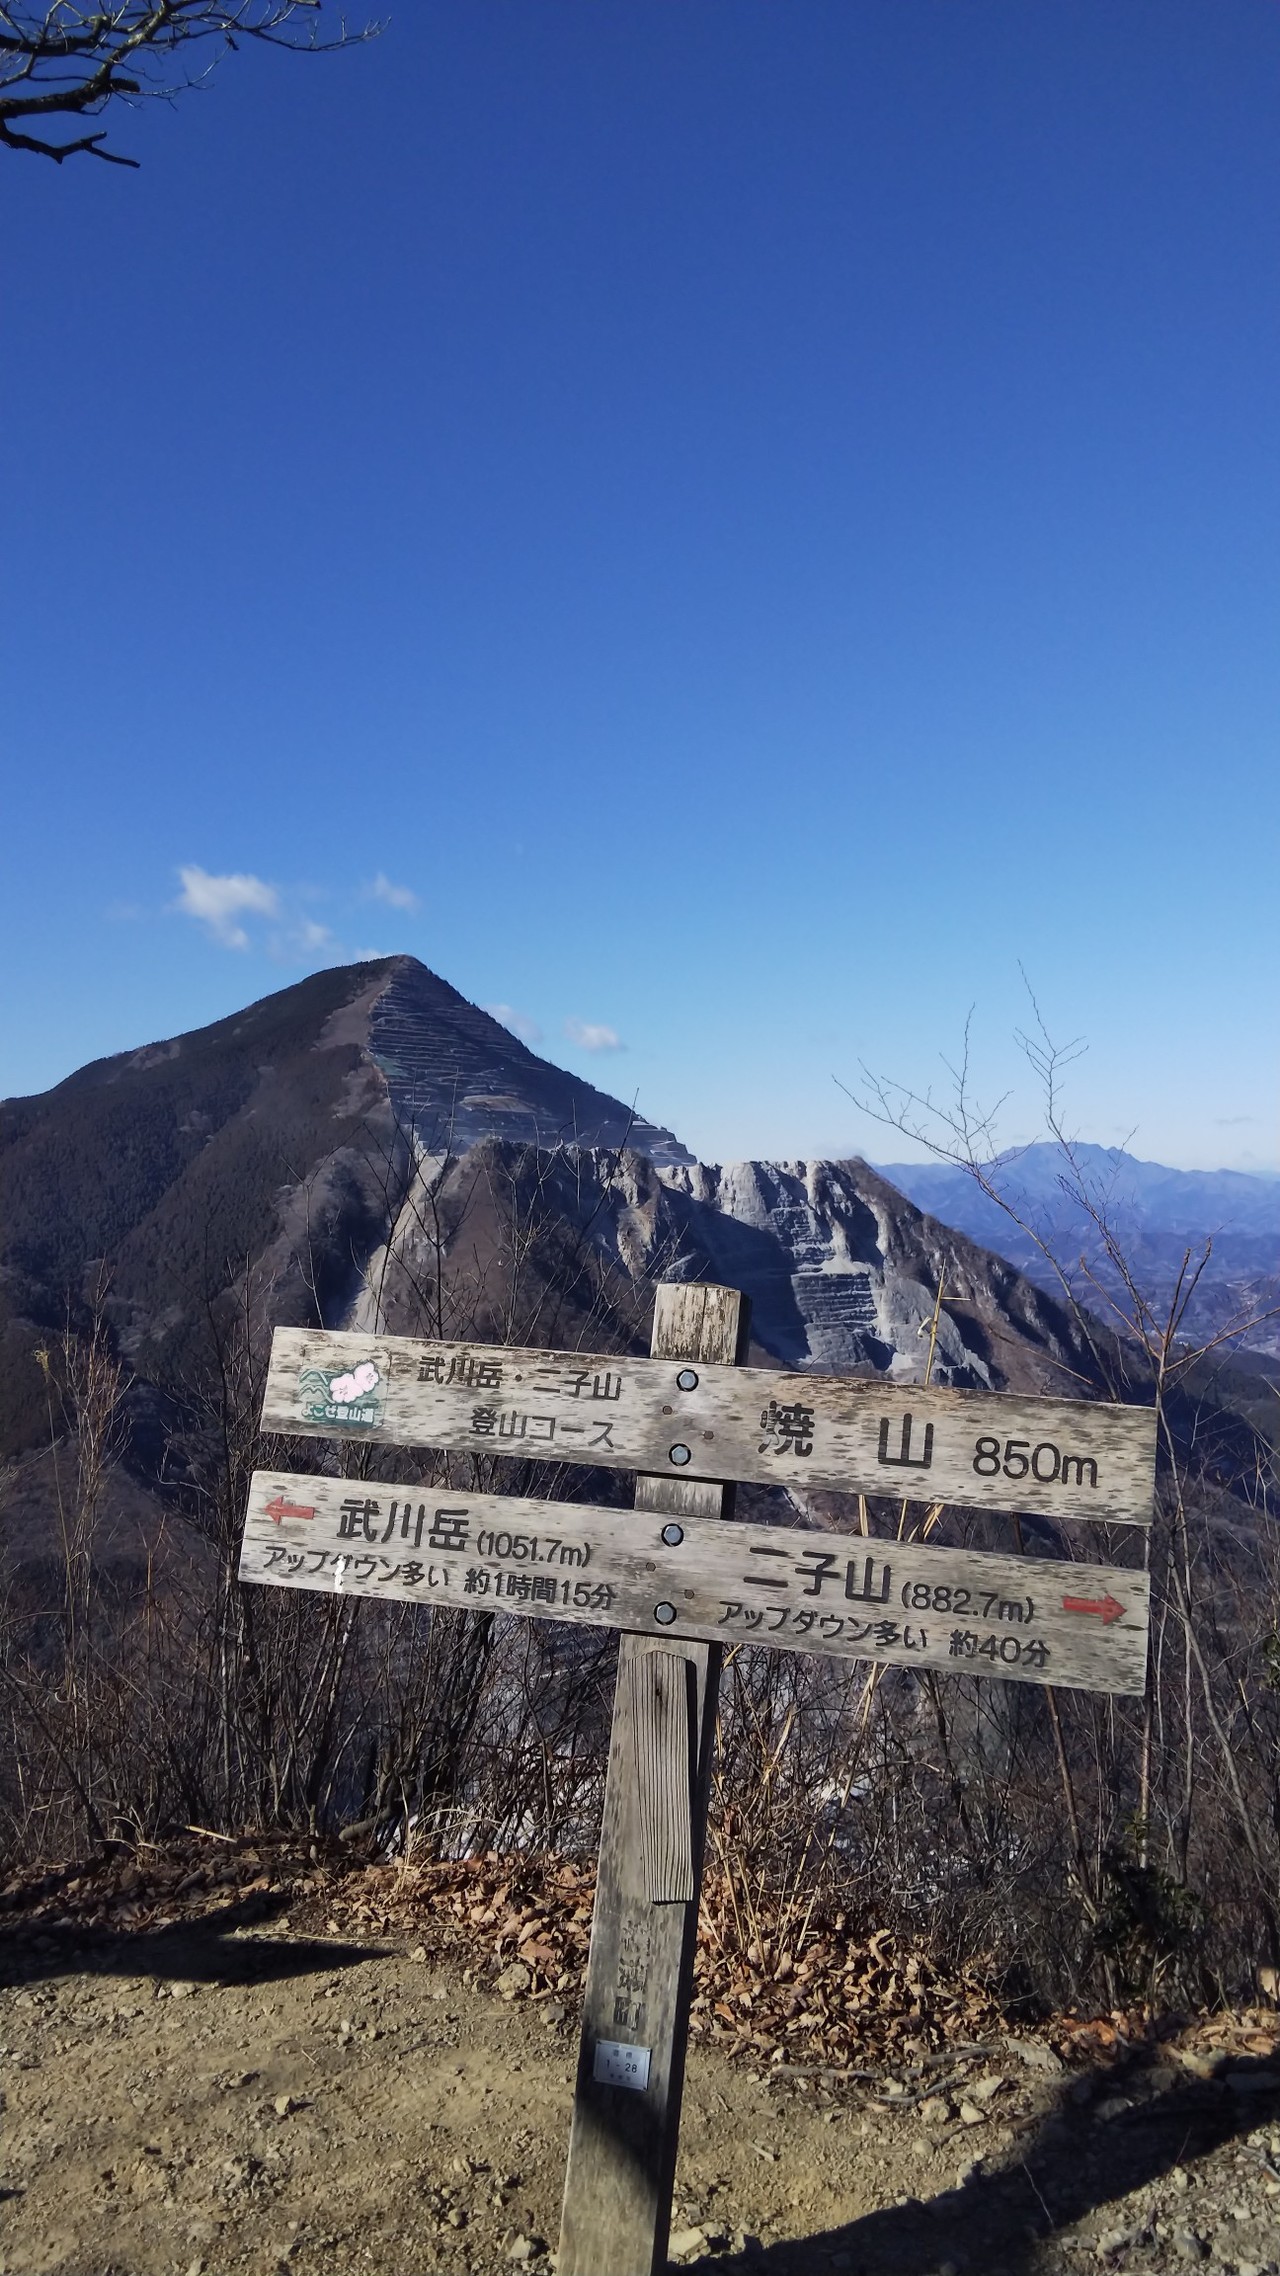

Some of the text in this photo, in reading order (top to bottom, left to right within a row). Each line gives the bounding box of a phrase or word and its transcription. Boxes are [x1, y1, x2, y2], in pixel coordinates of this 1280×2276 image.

[416, 1355, 622, 1401] 武川岳・二子山
[468, 1407, 614, 1448] 登山コース
[972, 1436, 1098, 1488] 850m
[717, 1601, 1051, 1668] アップダウン多い 約40分
